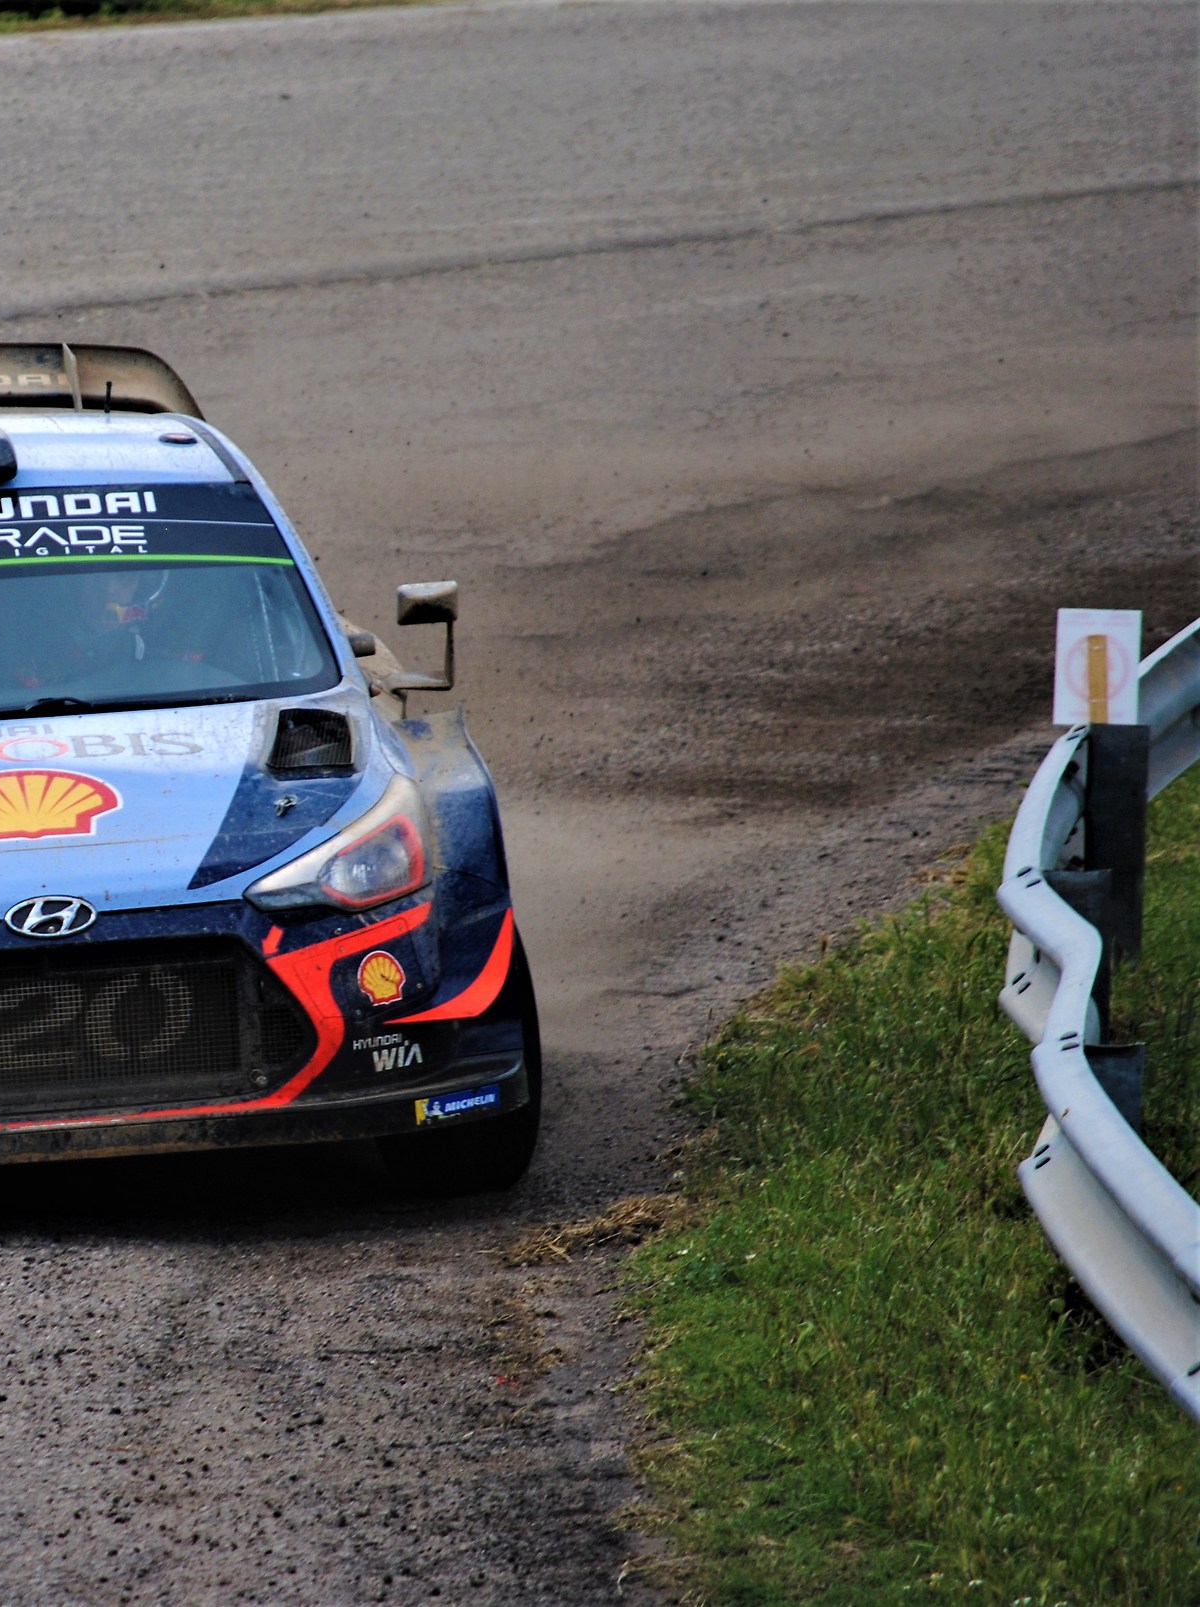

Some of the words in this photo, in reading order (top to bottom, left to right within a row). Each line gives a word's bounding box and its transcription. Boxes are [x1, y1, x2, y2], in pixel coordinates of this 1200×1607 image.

[353, 1033, 403, 1051] HYUNDAI
[372, 1040, 423, 1072] WIA
[445, 1093, 496, 1112] MICHELIN
